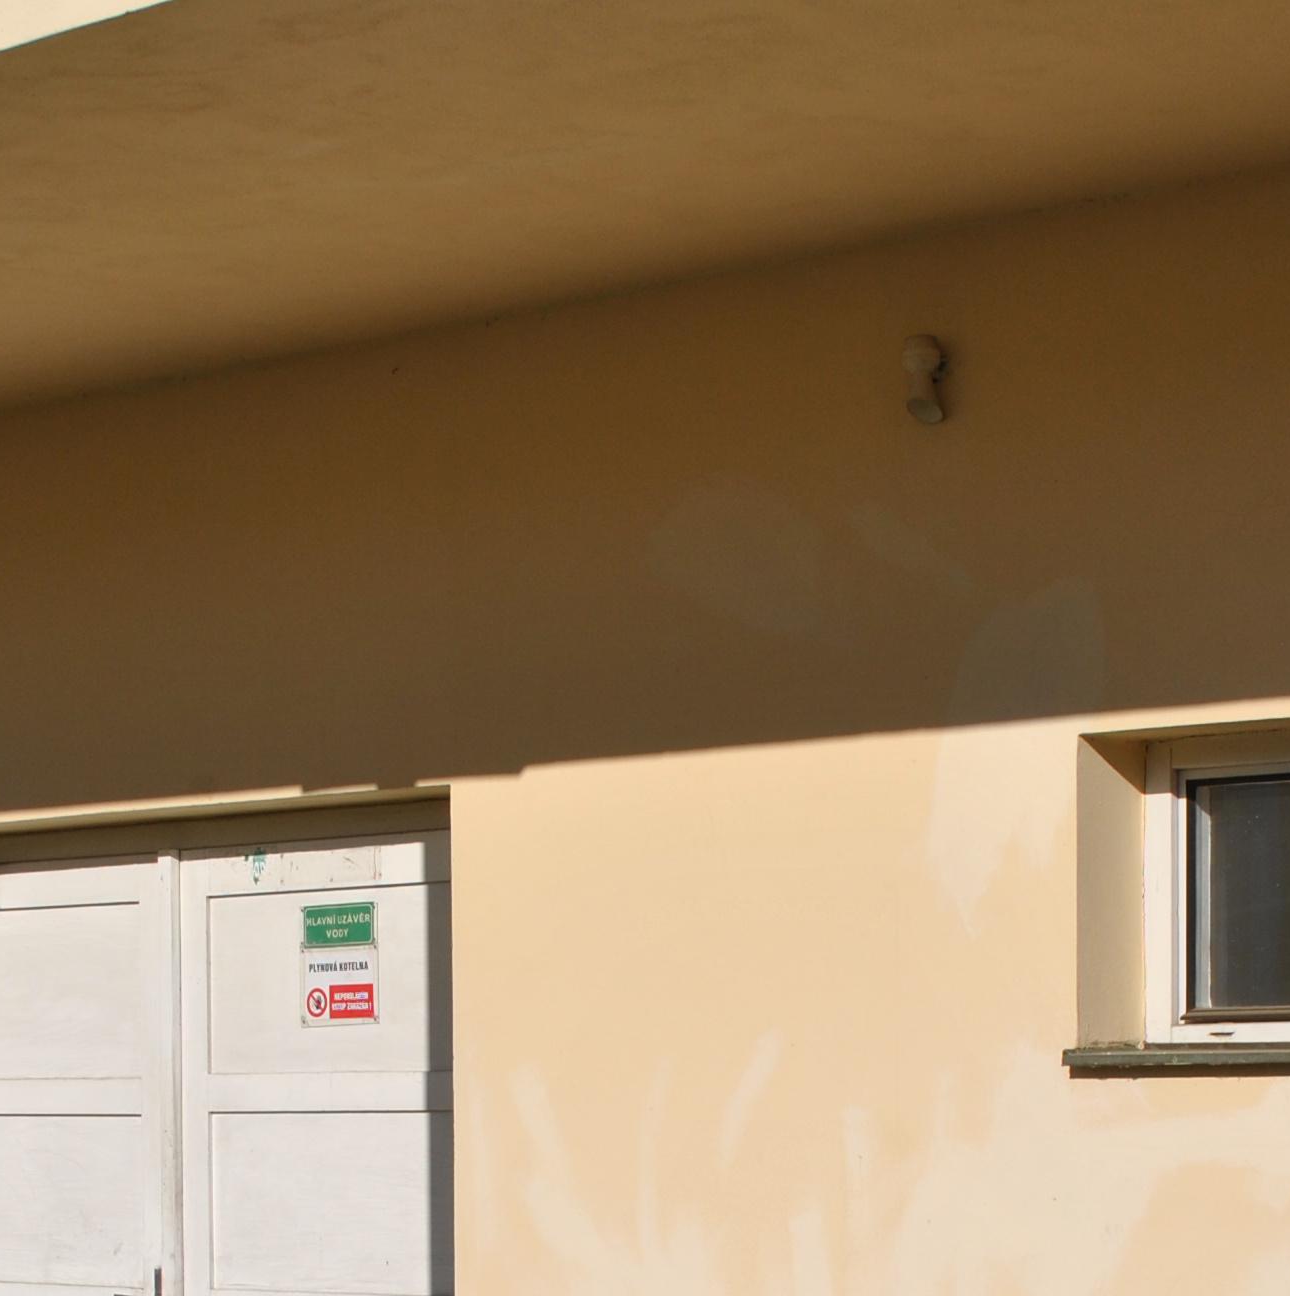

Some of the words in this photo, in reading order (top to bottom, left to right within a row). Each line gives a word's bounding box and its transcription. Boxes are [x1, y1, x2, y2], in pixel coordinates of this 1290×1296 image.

[306, 914, 336, 927] HLAVNÍ
[326, 929, 349, 939] VODY
[308, 961, 338, 973] PLYNOVÁ
[339, 961, 369, 972] KOTELNA
